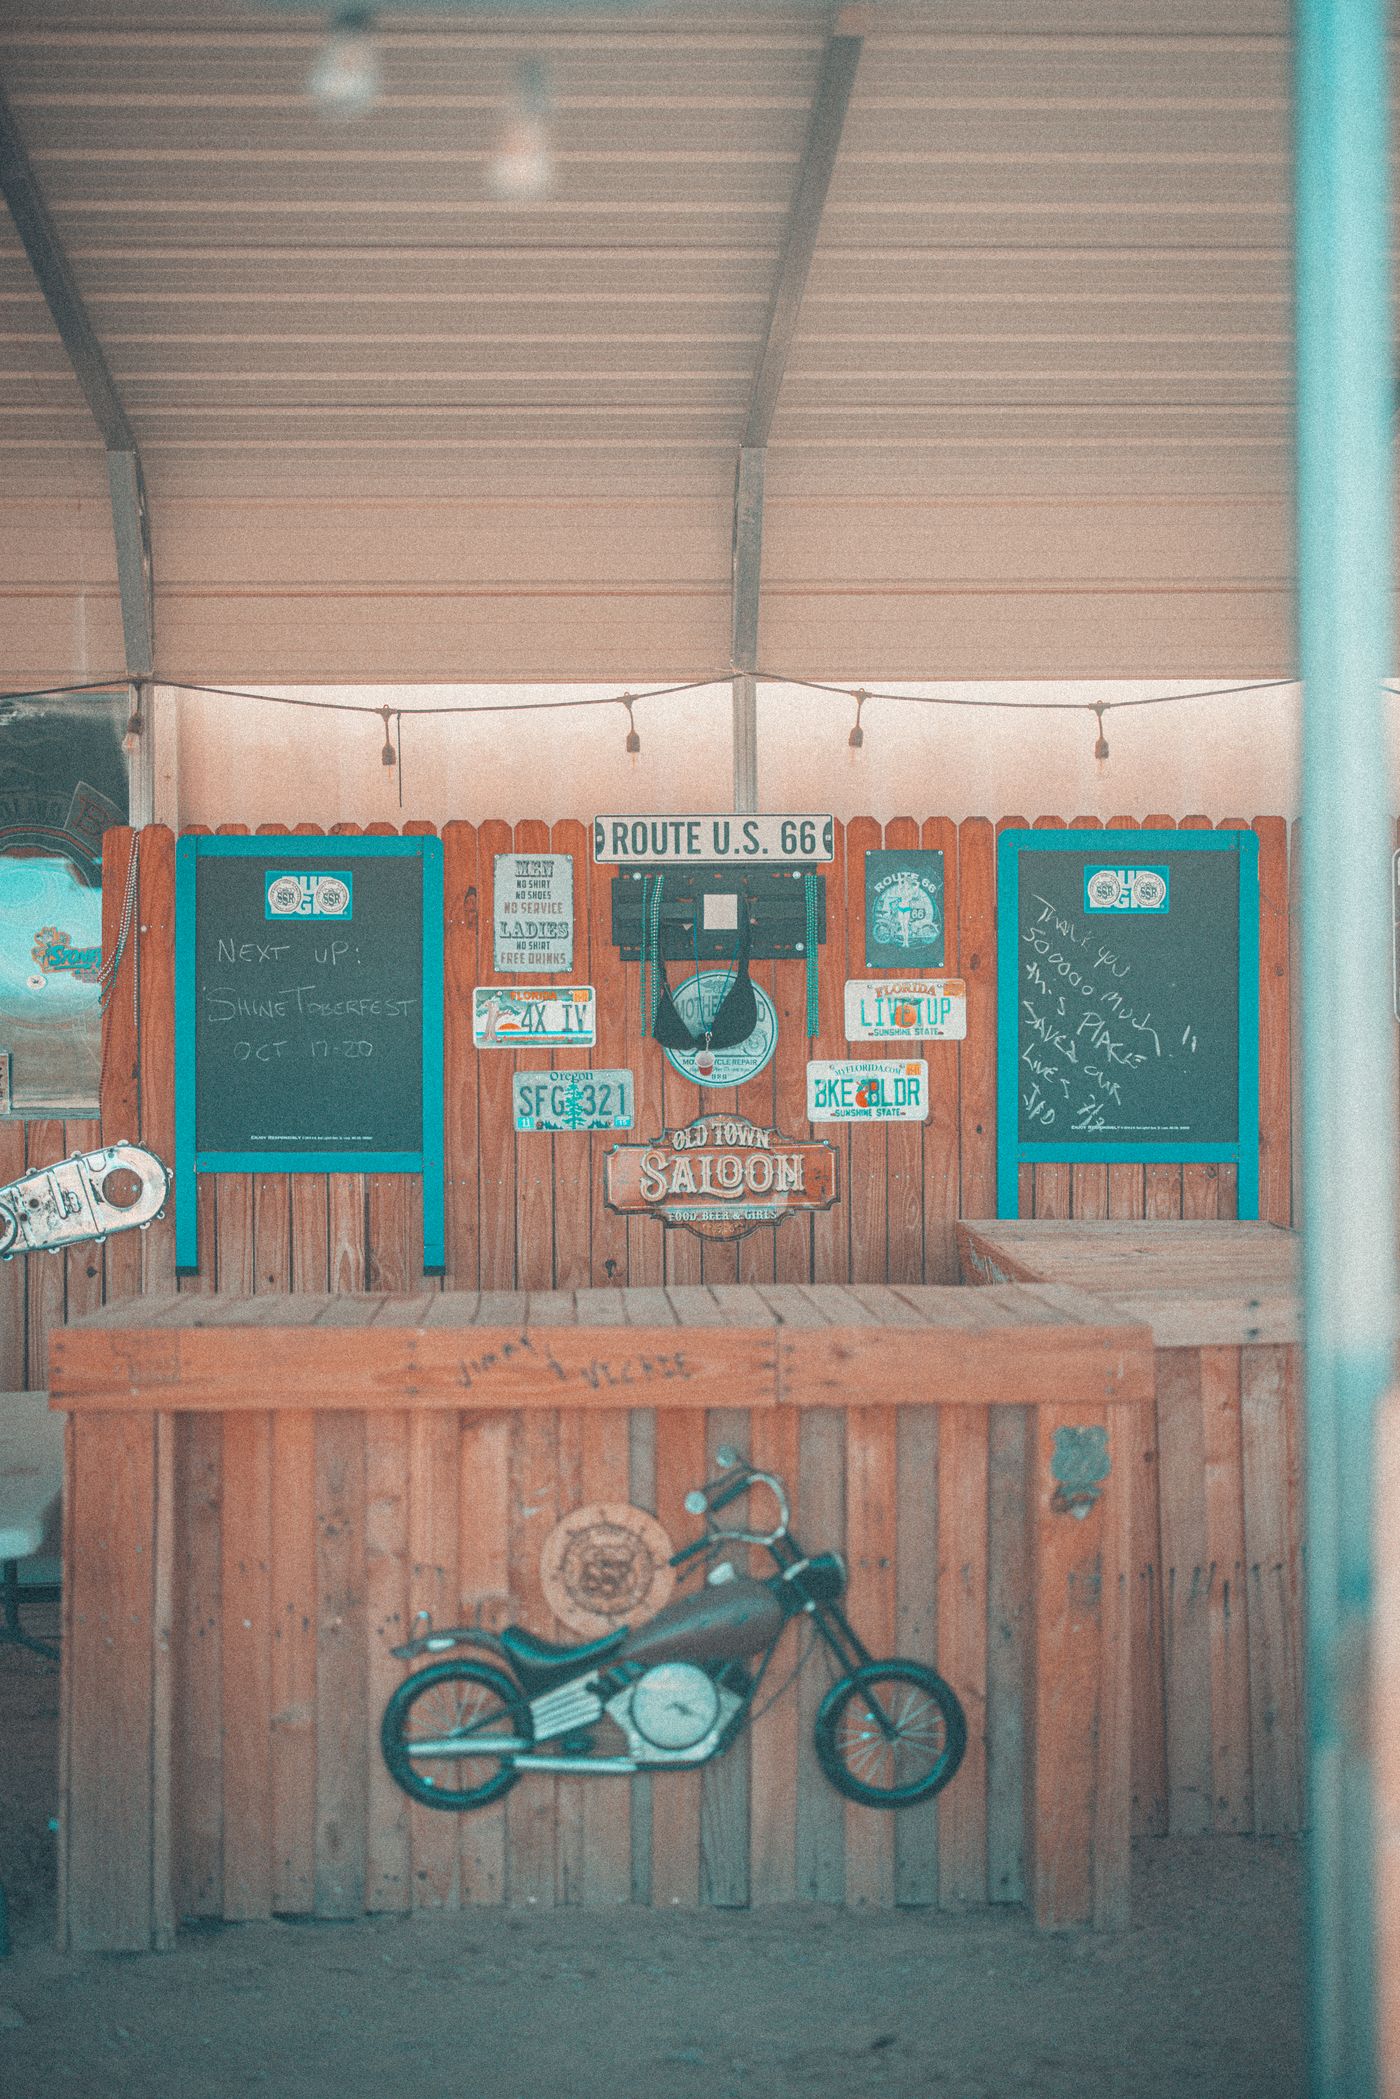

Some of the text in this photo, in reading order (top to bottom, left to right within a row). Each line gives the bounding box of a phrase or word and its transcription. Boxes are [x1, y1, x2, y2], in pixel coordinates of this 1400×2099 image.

[611, 819, 817, 856] ROUTE U.S. 66
[514, 860, 555, 878] MEN
[516, 879, 551, 889] NO SHIRT
[874, 871, 938, 894] ROUTE 66
[515, 890, 552, 900] NO SHOES
[504, 901, 564, 914] NO SERVICE
[911, 909, 926, 920] 66
[499, 921, 570, 940] LADIES
[218, 938, 290, 963] NEXT
[516, 941, 551, 950] NO SHIRT
[500, 952, 566, 965] FREE DRINKS
[510, 991, 557, 1001] FLORIDA
[875, 982, 937, 998] FLORIDA
[873, 1027, 939, 1037] SUNSHINE STATE
[233, 1040, 288, 1062] OCT
[549, 1071, 593, 1083] Oregon
[519, 1083, 625, 1117] SFG 321
[814, 1078, 854, 1108] BKE
[834, 1108, 902, 1117] SUNSHINE STATE
[672, 1122, 771, 1150] OLD TOWN
[639, 1149, 806, 1202] SALOON
[701, 1210, 730, 1221] BEER
[744, 1208, 778, 1220] GIRLS
